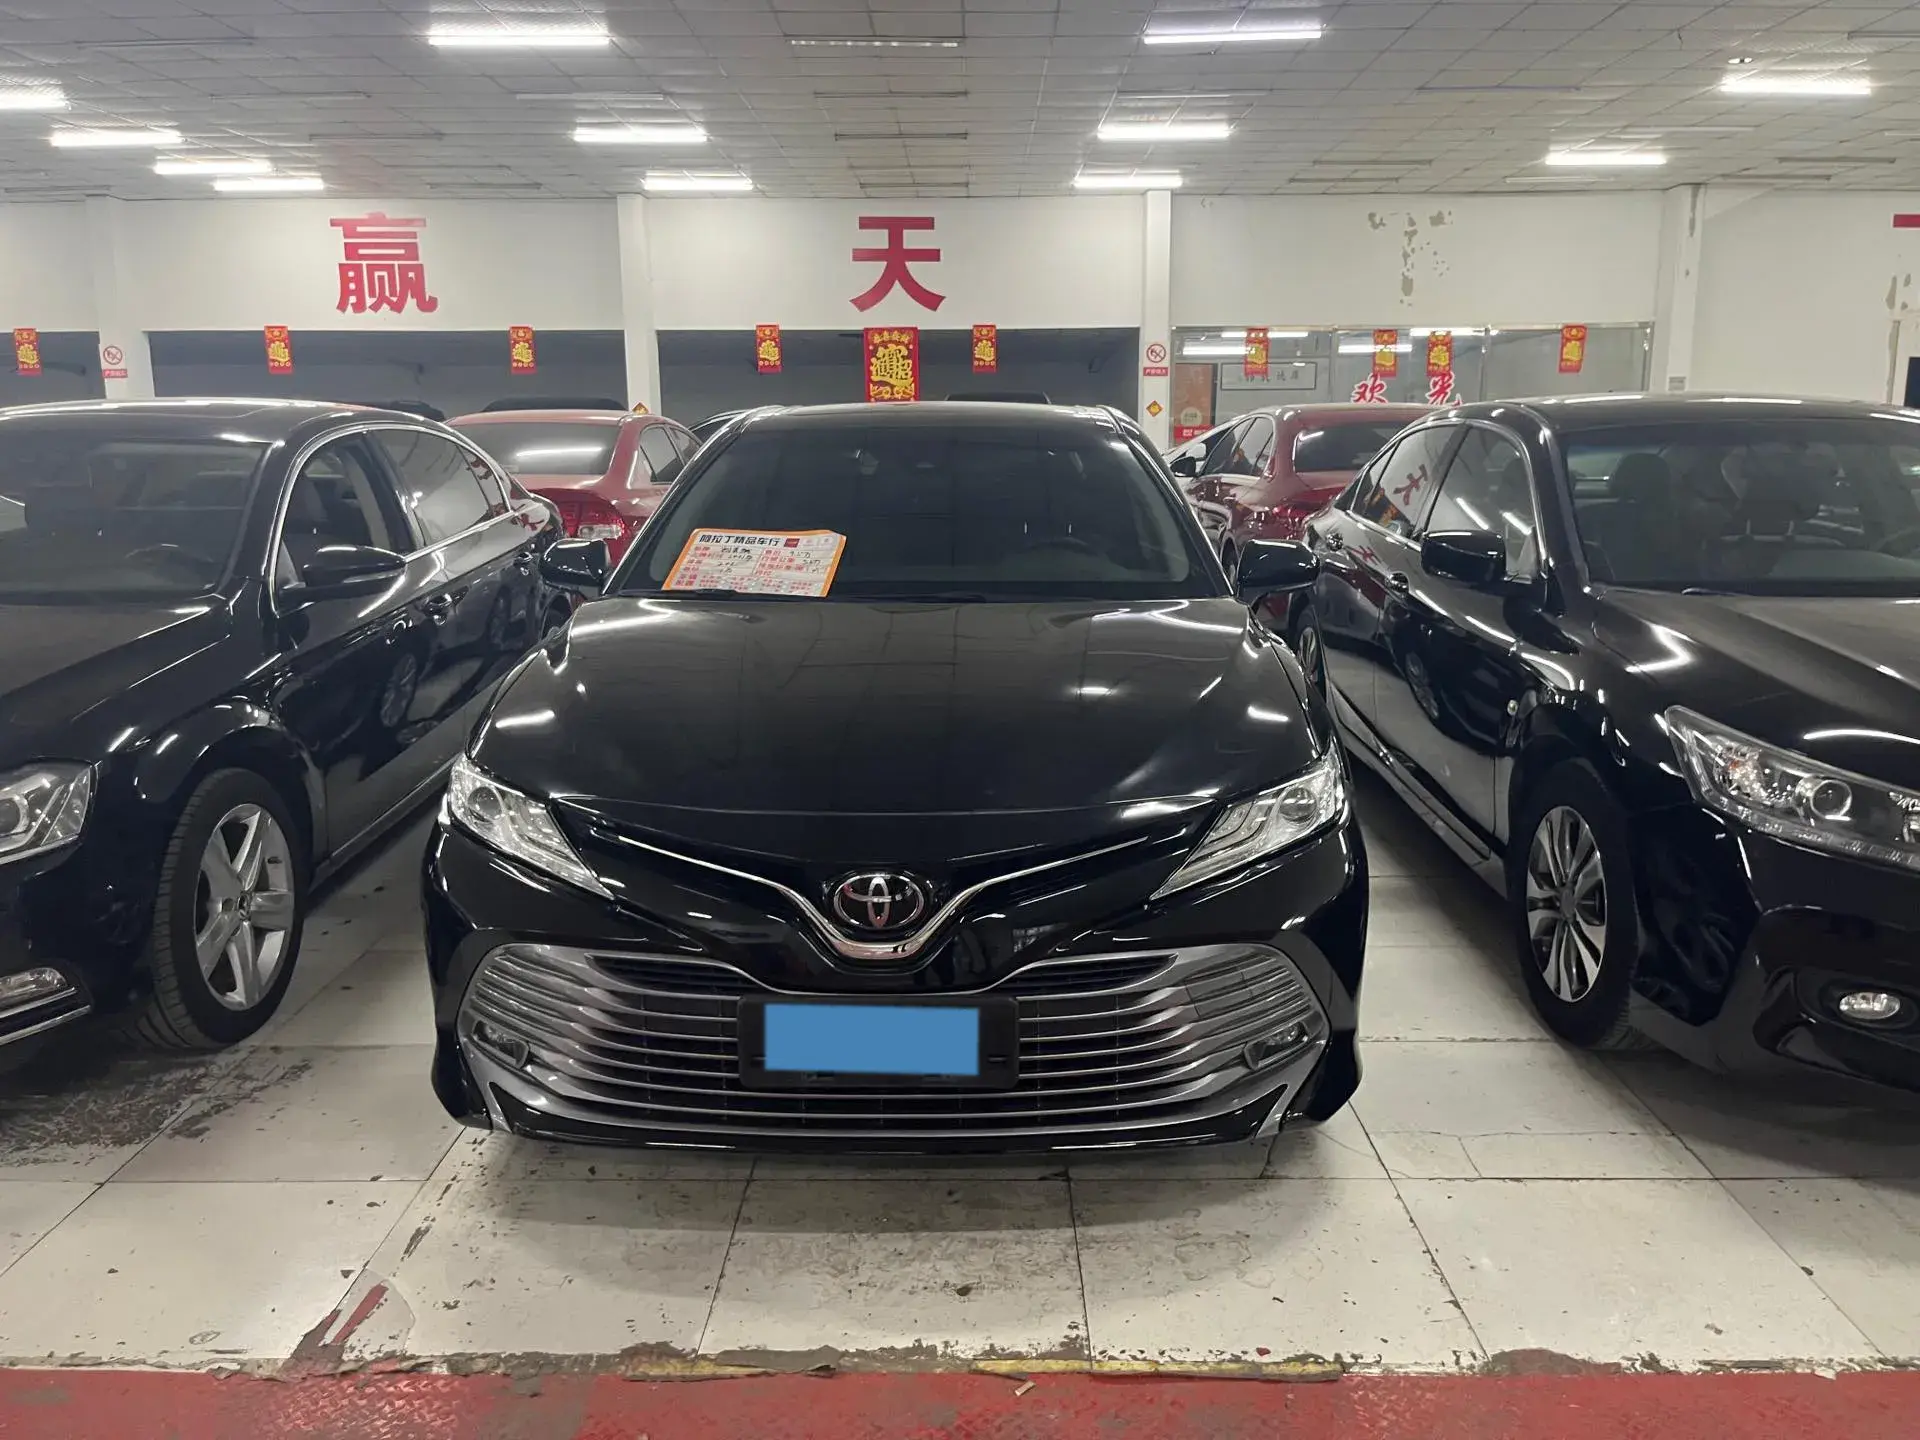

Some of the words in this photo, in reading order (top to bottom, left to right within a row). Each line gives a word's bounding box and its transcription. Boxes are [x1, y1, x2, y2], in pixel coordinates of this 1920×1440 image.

[330, 212, 438, 314] 赢
[850, 217, 946, 312] 天
[699, 534, 781, 547] 阿拉丁精品车行
